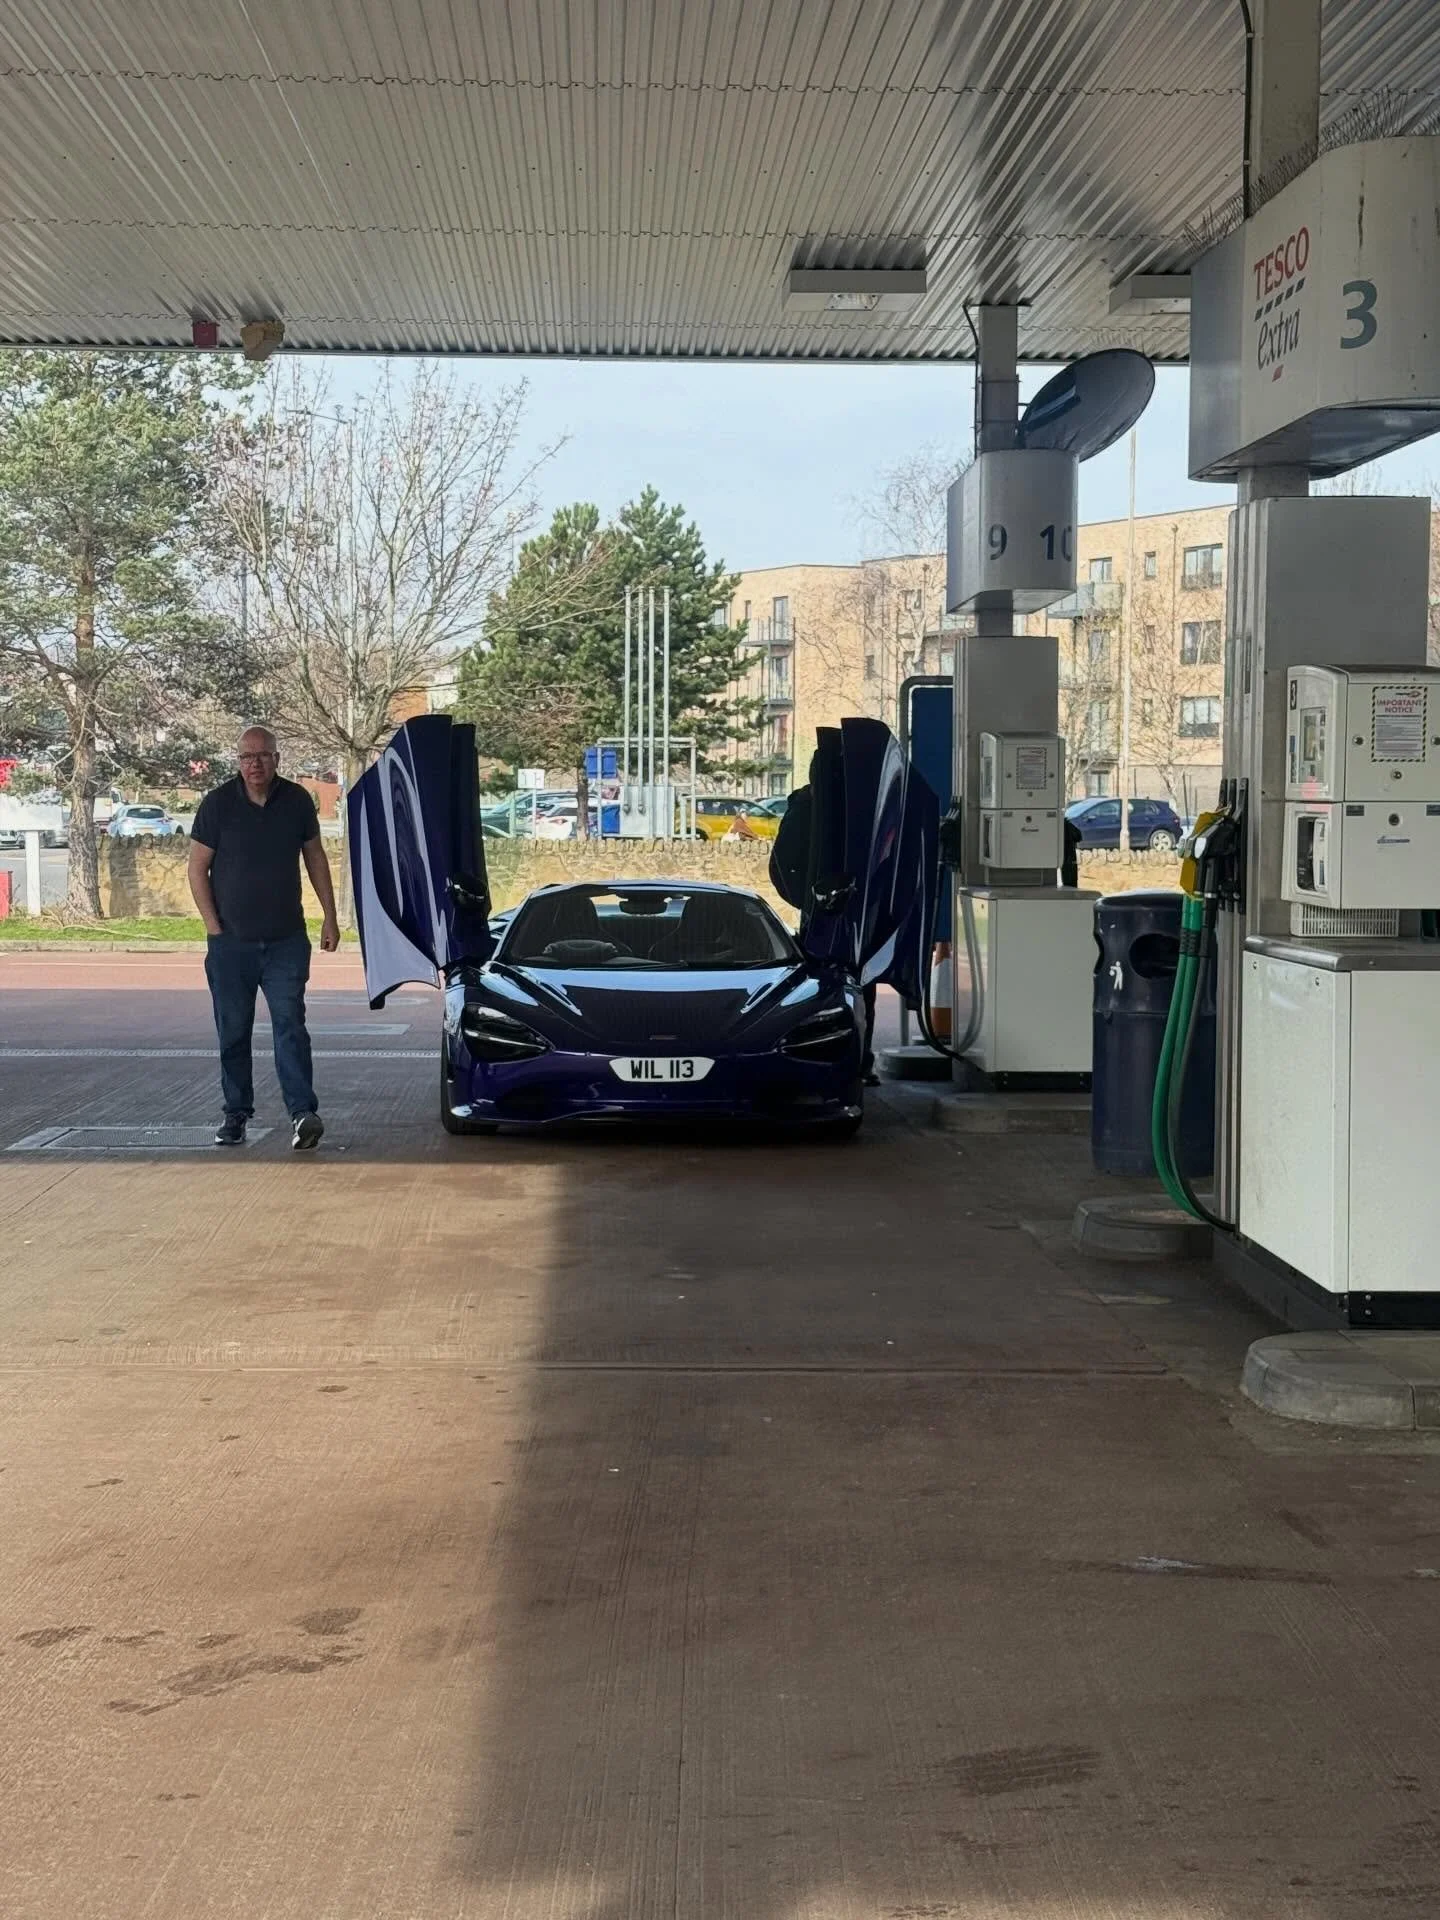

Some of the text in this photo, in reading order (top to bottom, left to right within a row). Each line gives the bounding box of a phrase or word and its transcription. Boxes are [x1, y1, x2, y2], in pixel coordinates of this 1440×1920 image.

[1253, 225, 1310, 301] TESCO
[1257, 307, 1301, 371] extra
[1339, 279, 1379, 350] 3
[988, 523, 1008, 561] 9
[630, 1059, 694, 1079] WIL 113
